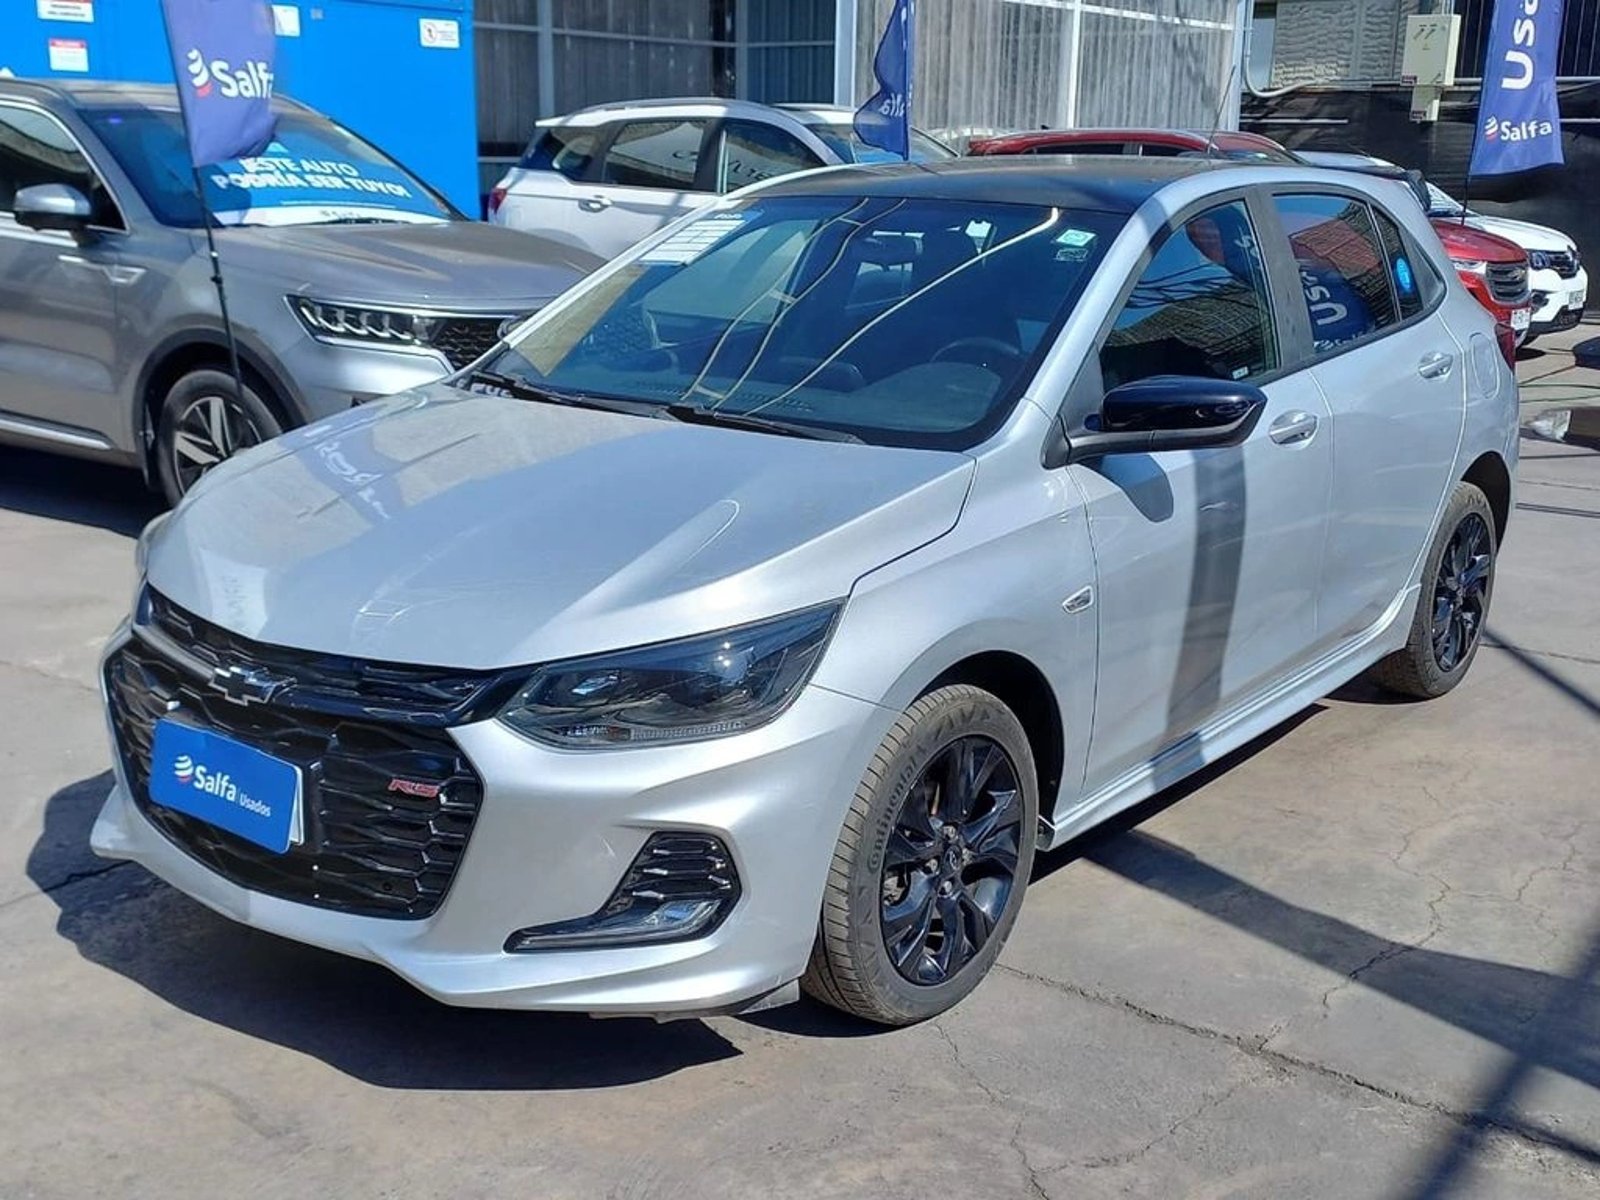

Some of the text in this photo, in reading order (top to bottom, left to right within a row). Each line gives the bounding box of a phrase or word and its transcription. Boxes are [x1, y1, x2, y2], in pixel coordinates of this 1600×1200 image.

[1500, 120, 1552, 141] Salfa
[300, 159, 359, 177] AUTO
[304, 174, 351, 189] SER
[193, 765, 271, 817] Salfa Usados
[388, 778, 440, 798] RS
